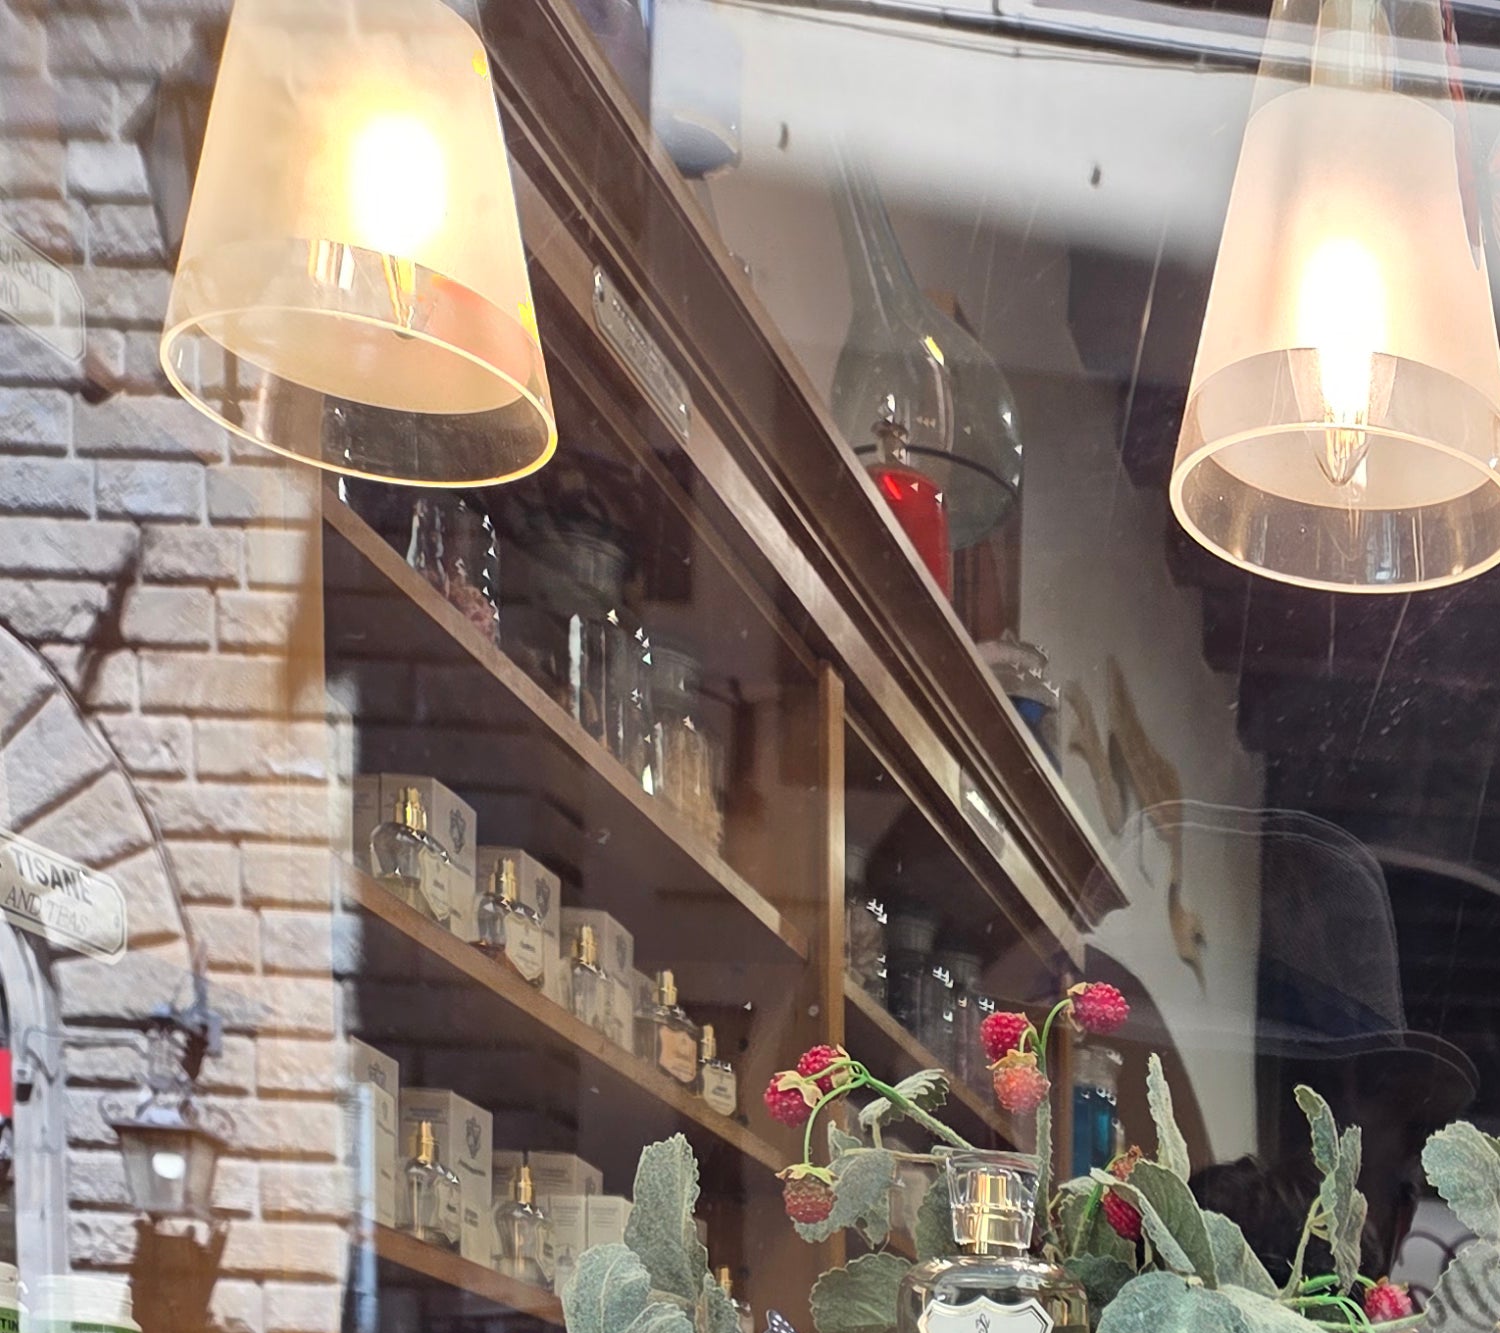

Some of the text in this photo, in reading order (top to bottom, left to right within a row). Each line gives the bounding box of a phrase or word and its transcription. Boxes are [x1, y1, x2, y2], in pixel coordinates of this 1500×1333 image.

[11, 846, 93, 906] TISANE
[5, 885, 89, 935] AND TEAS
